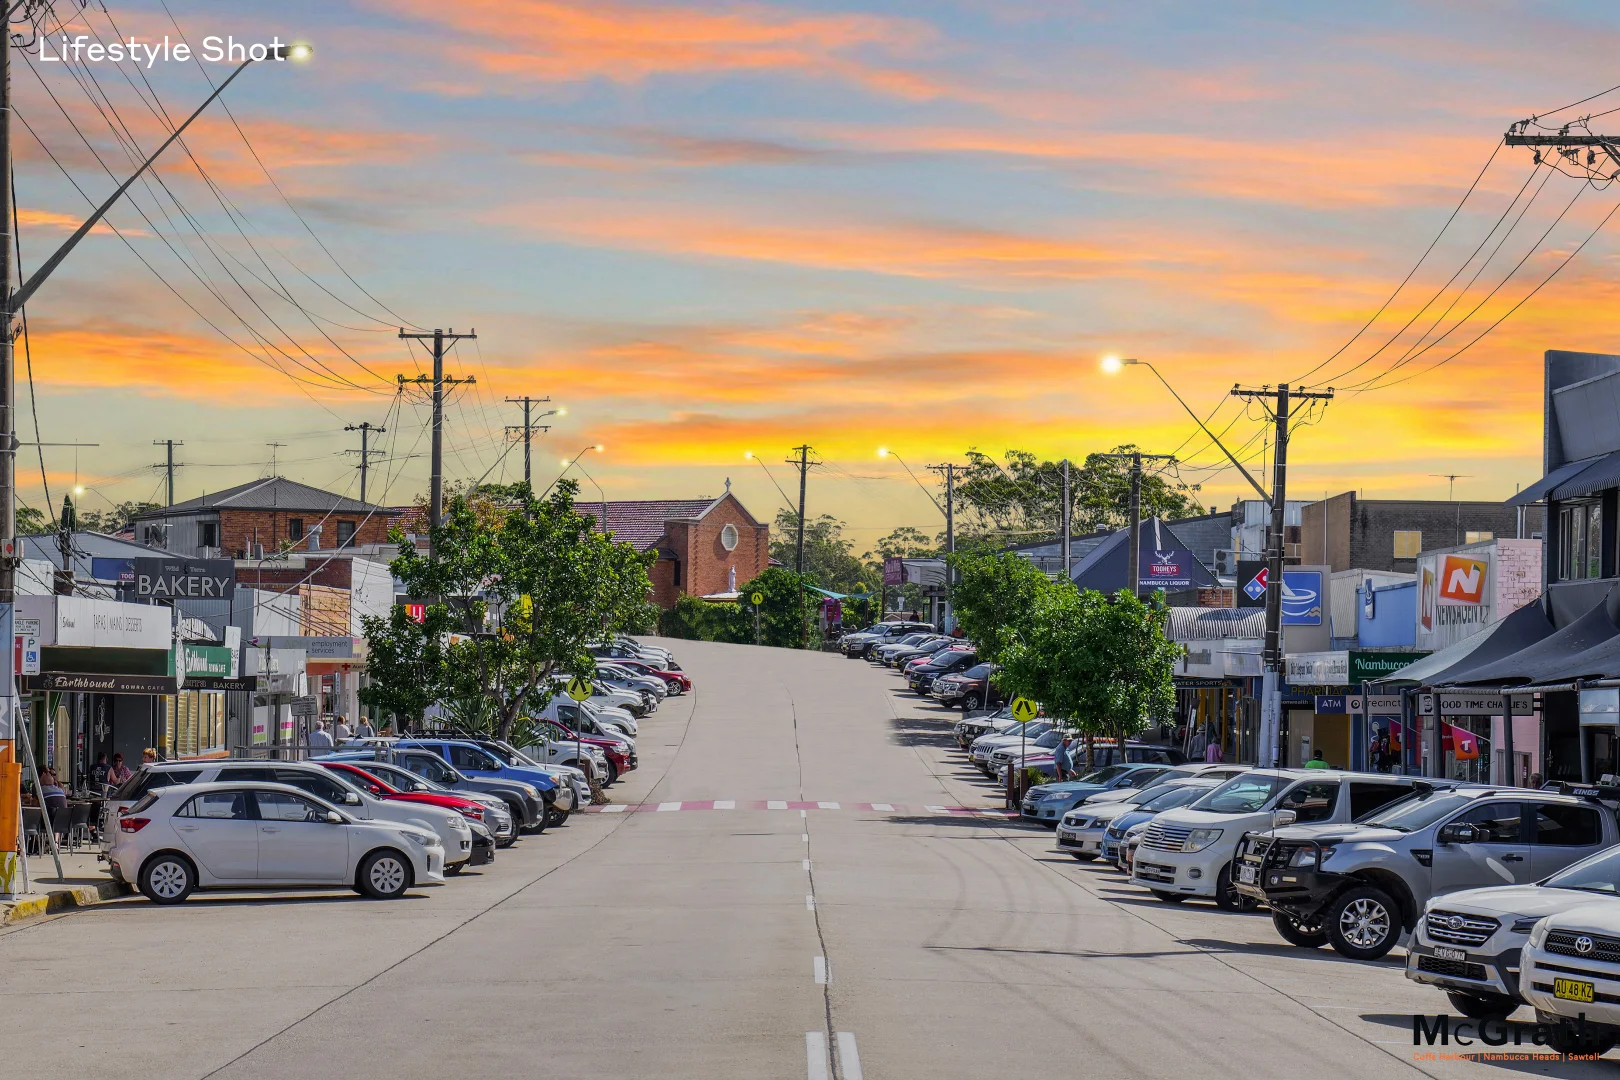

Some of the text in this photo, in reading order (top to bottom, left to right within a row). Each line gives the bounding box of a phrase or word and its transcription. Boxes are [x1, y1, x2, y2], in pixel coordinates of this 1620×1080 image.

[138, 574, 230, 597] BAKERY
[28, 639, 35, 648] P
[54, 676, 116, 690] Earthbound
[213, 682, 246, 690] BAKERY
[1291, 686, 1354, 696] PHARMACY
[1321, 699, 1341, 708] ATM
[1362, 699, 1402, 710] recinct
[1440, 700, 1528, 709] OOD TIME CHALIE'S
[1461, 740, 1471, 751] T
[1572, 788, 1600, 796] KINGS
